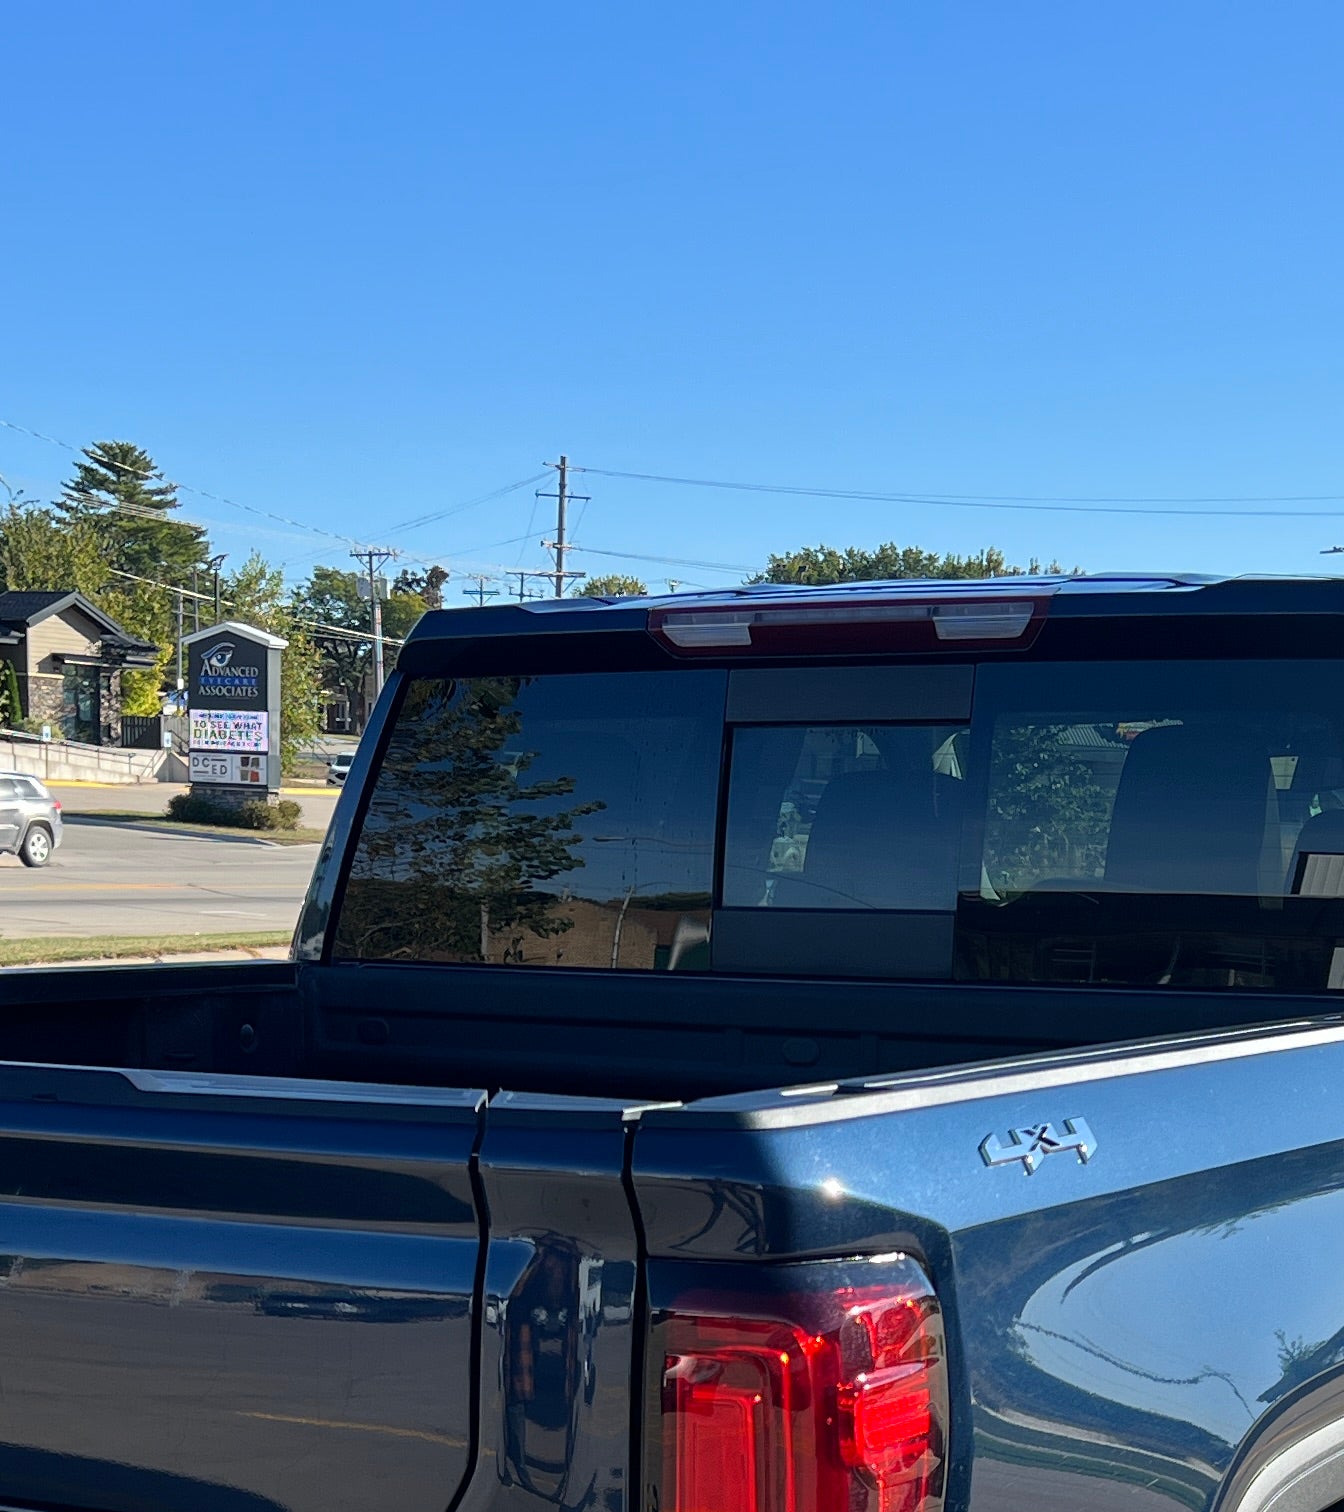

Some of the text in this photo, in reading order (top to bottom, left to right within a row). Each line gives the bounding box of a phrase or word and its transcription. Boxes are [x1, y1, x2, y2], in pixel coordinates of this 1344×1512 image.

[200, 659, 259, 677] ADVANCED
[201, 677, 256, 685] EYECARE
[198, 686, 259, 697] ASSOCIATES
[194, 720, 262, 730] TO SEE WHAT
[194, 729, 263, 740] DIABETES
